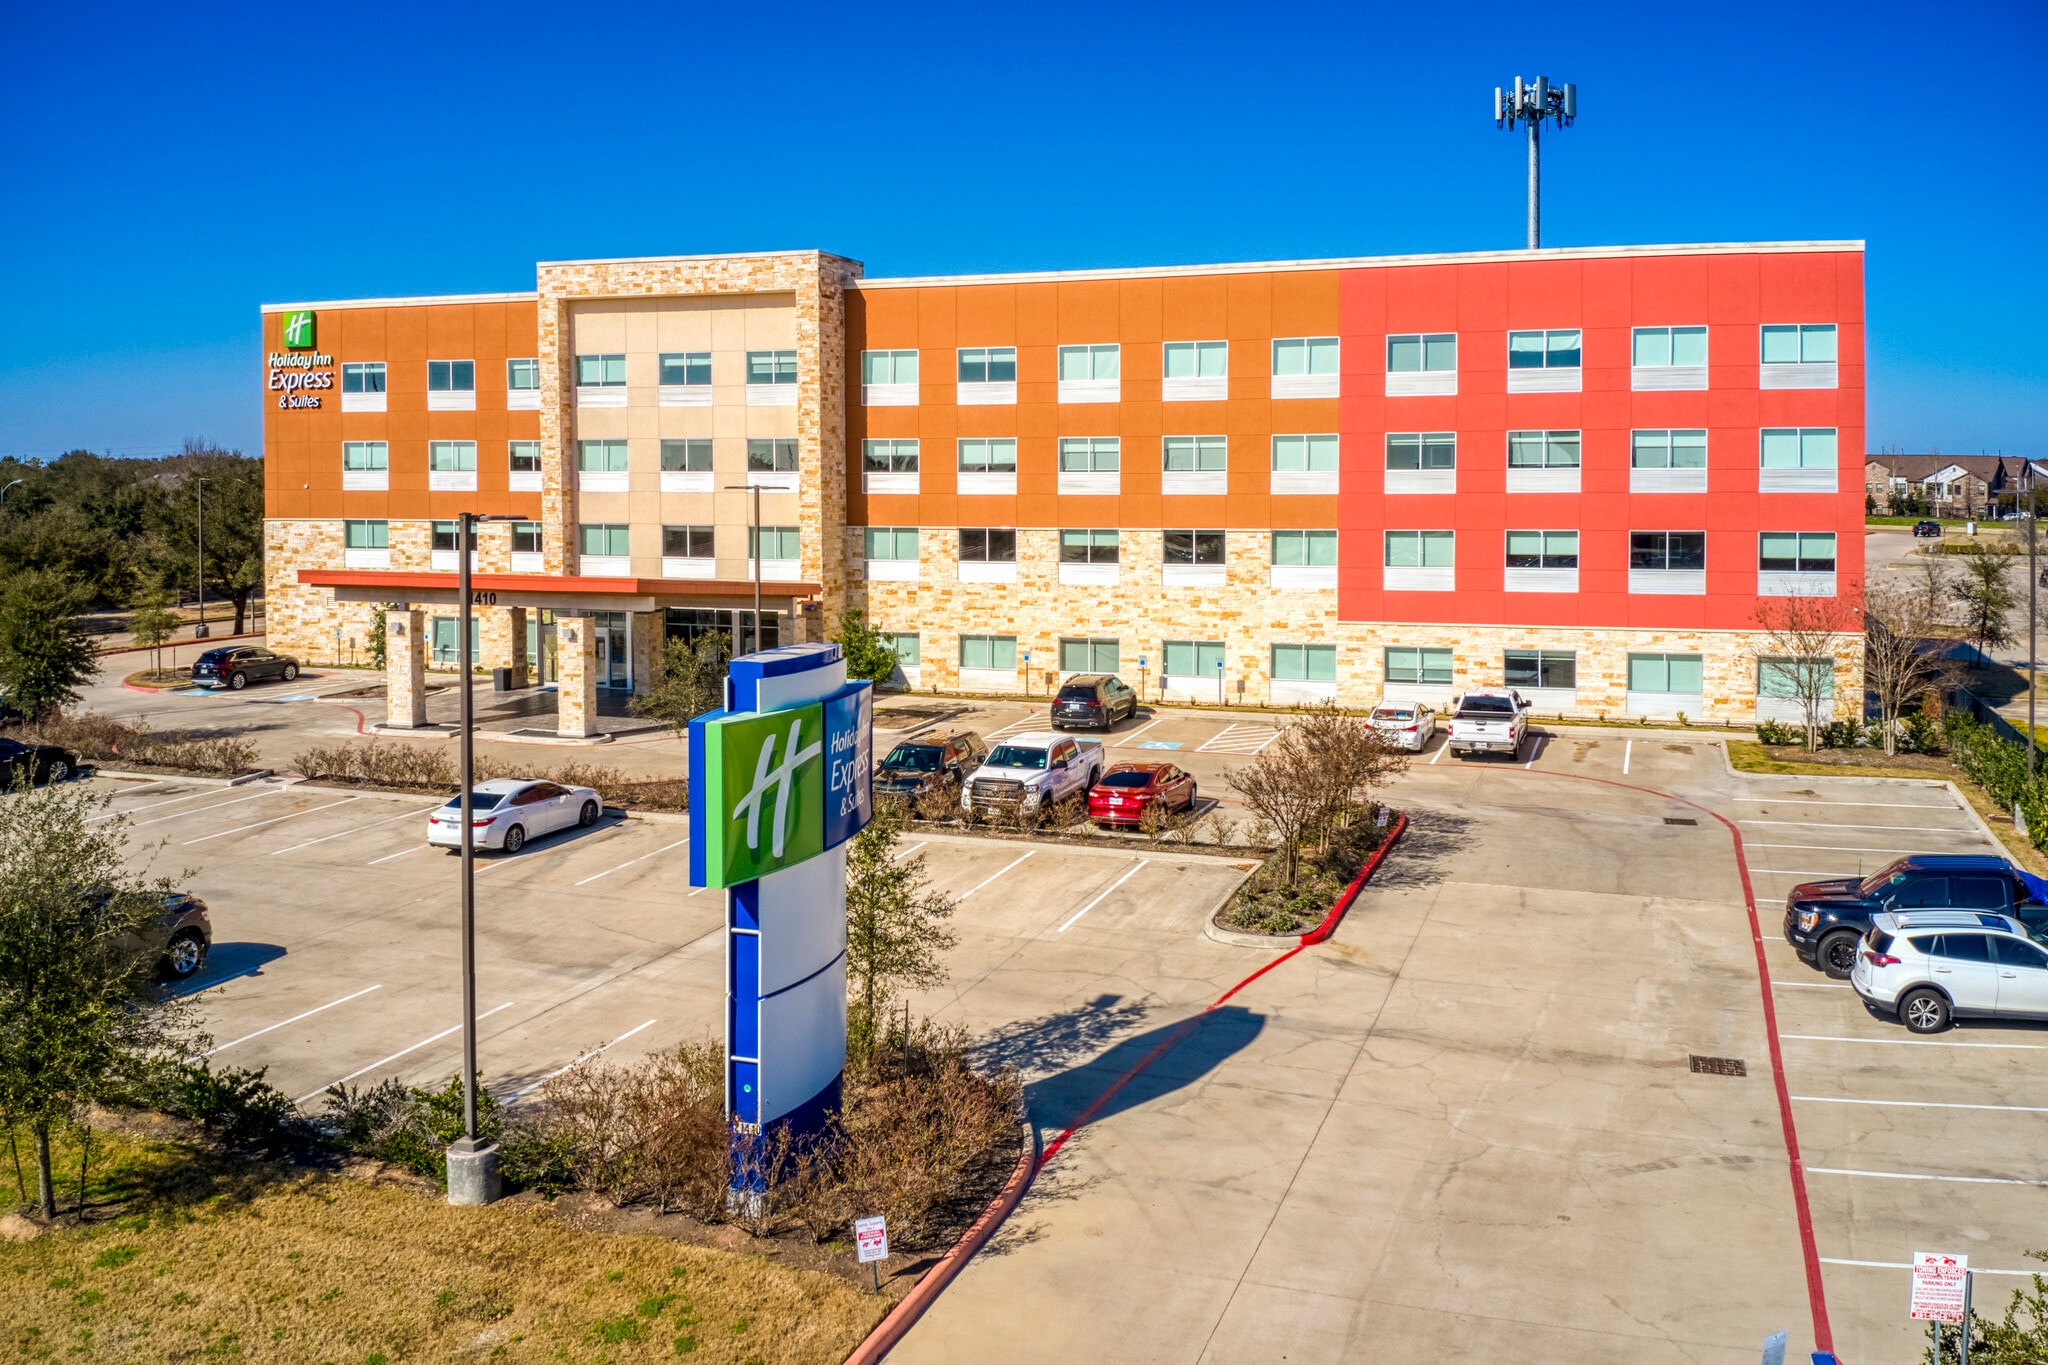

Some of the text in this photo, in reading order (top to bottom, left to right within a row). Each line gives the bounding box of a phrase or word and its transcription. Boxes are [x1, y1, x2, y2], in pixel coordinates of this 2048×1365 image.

[268, 350, 331, 369] Holiday Inn
[268, 369, 332, 394] Express
[279, 395, 320, 408] & Suites
[831, 748, 869, 793] Express
[840, 788, 865, 817] & Suites
[1915, 1265, 1966, 1276] TOWING ENFORCED
